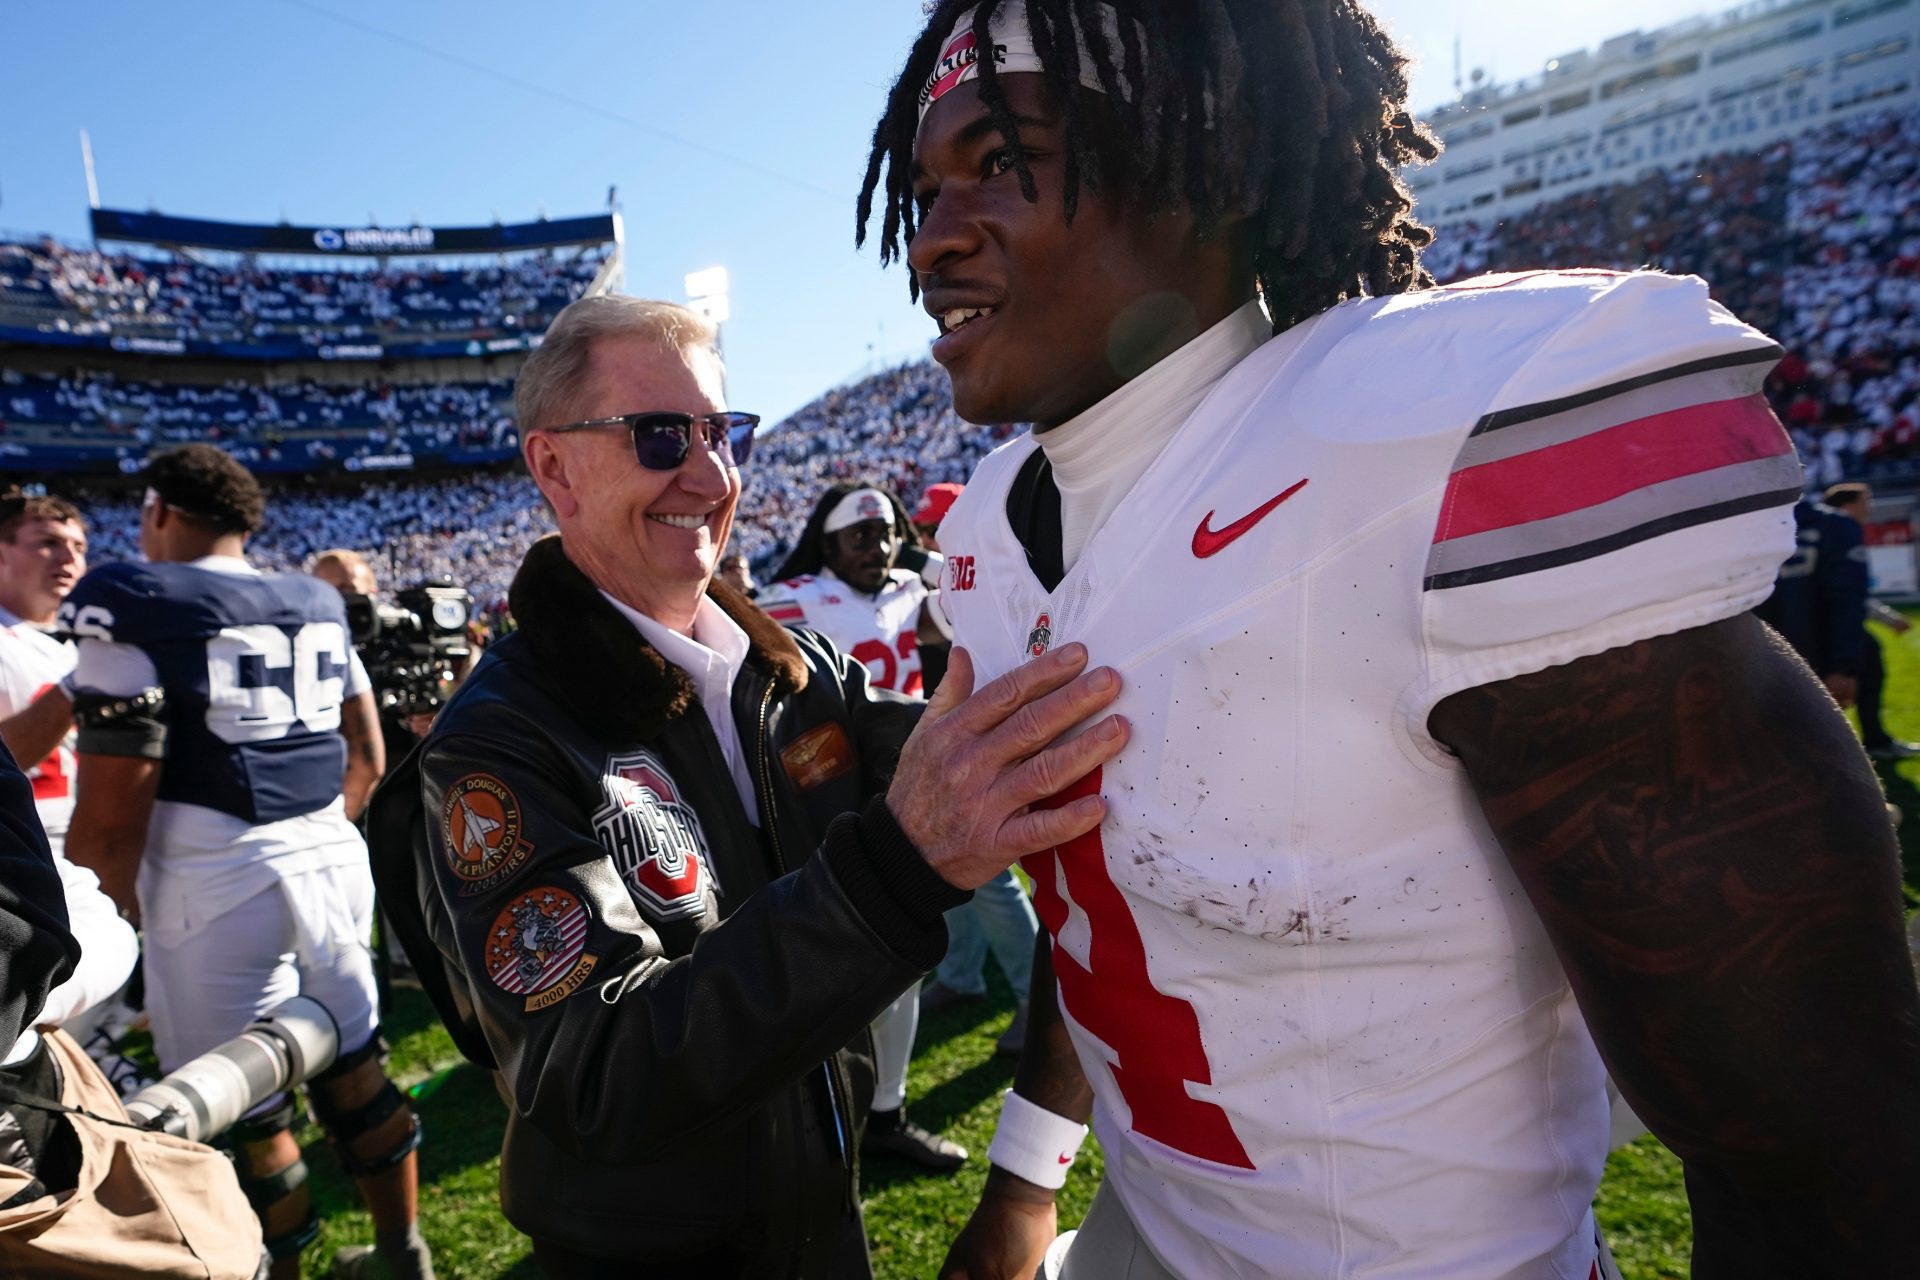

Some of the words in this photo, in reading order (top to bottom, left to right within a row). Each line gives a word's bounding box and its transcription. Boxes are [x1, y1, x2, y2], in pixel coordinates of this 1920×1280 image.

[466, 779, 507, 801] DOUGLAS
[471, 824, 518, 876] PHANTOM
[500, 849, 526, 878] HRS
[534, 985, 565, 1009] 4000
[565, 960, 593, 989] HRS
[1019, 763, 1257, 1170] 4
